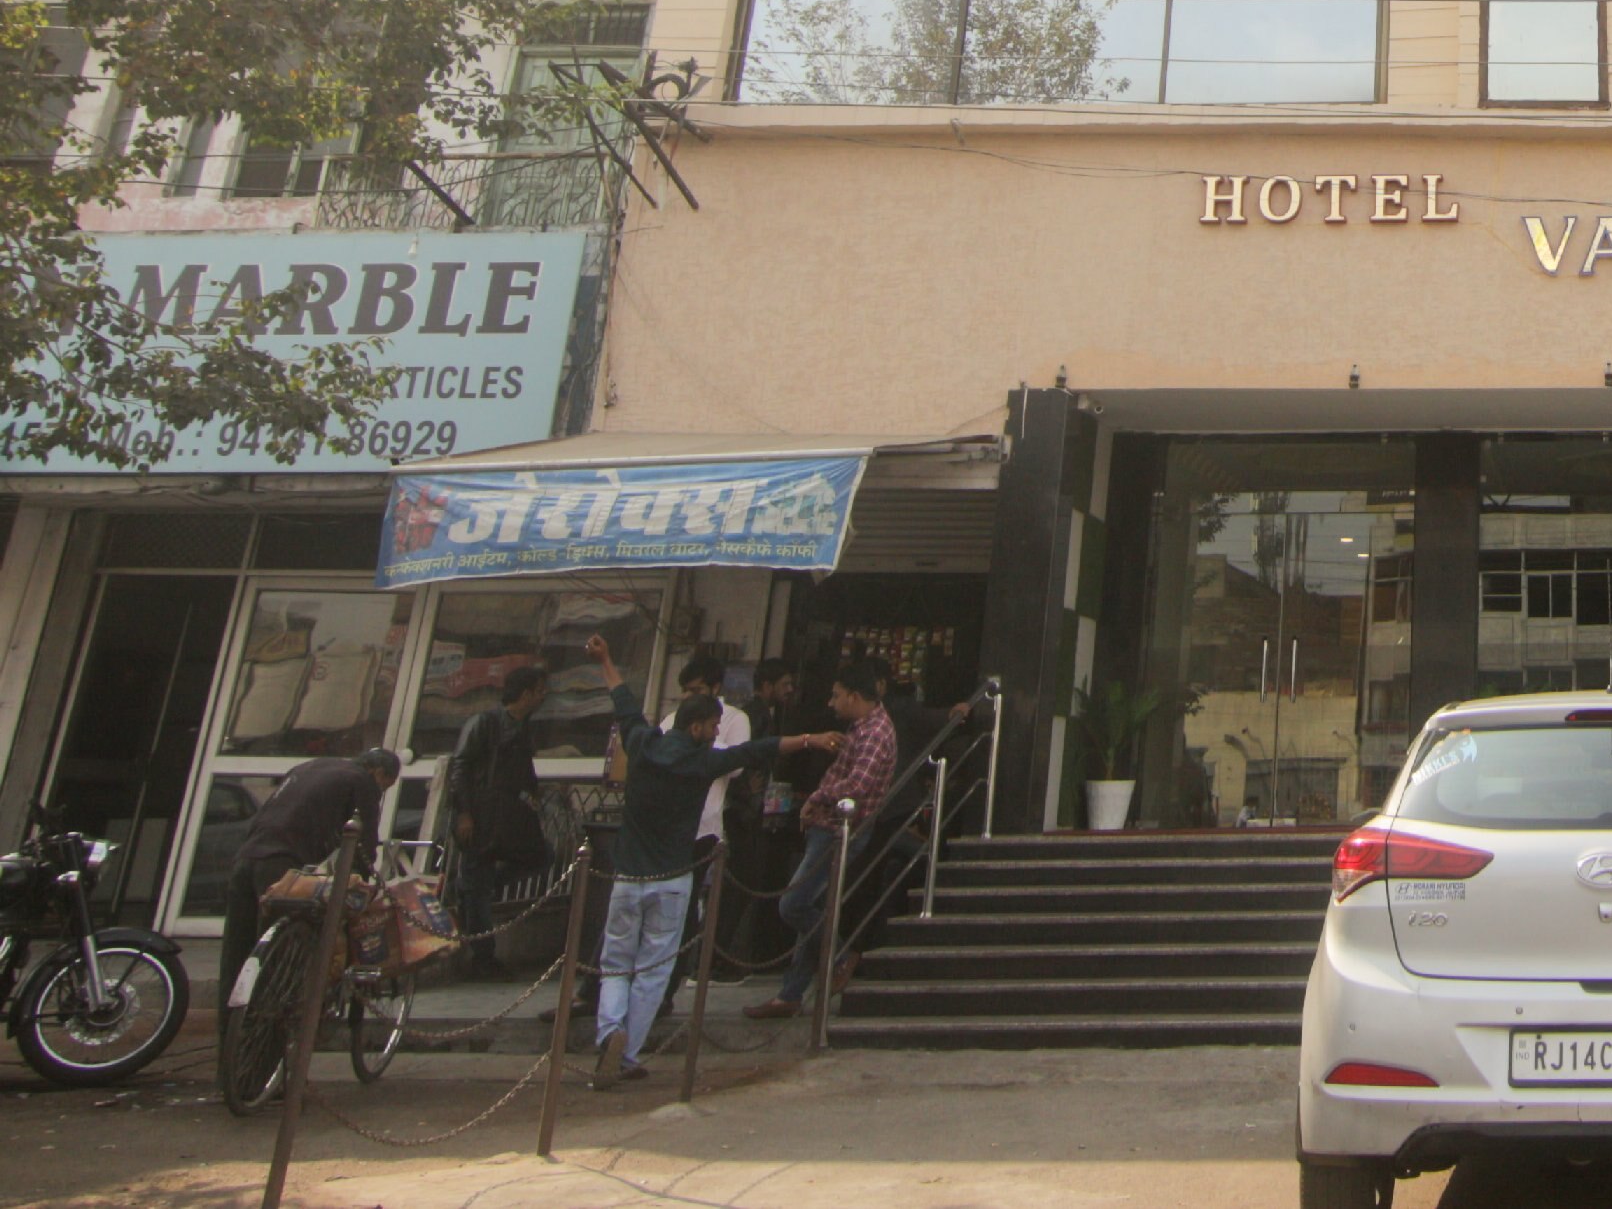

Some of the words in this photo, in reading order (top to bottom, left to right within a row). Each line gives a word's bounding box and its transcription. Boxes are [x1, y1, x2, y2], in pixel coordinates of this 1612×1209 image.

[1200, 174, 1459, 224] HOTEL
[111, 262, 541, 337] MARBLE
[1515, 1052, 1530, 1060] IND
